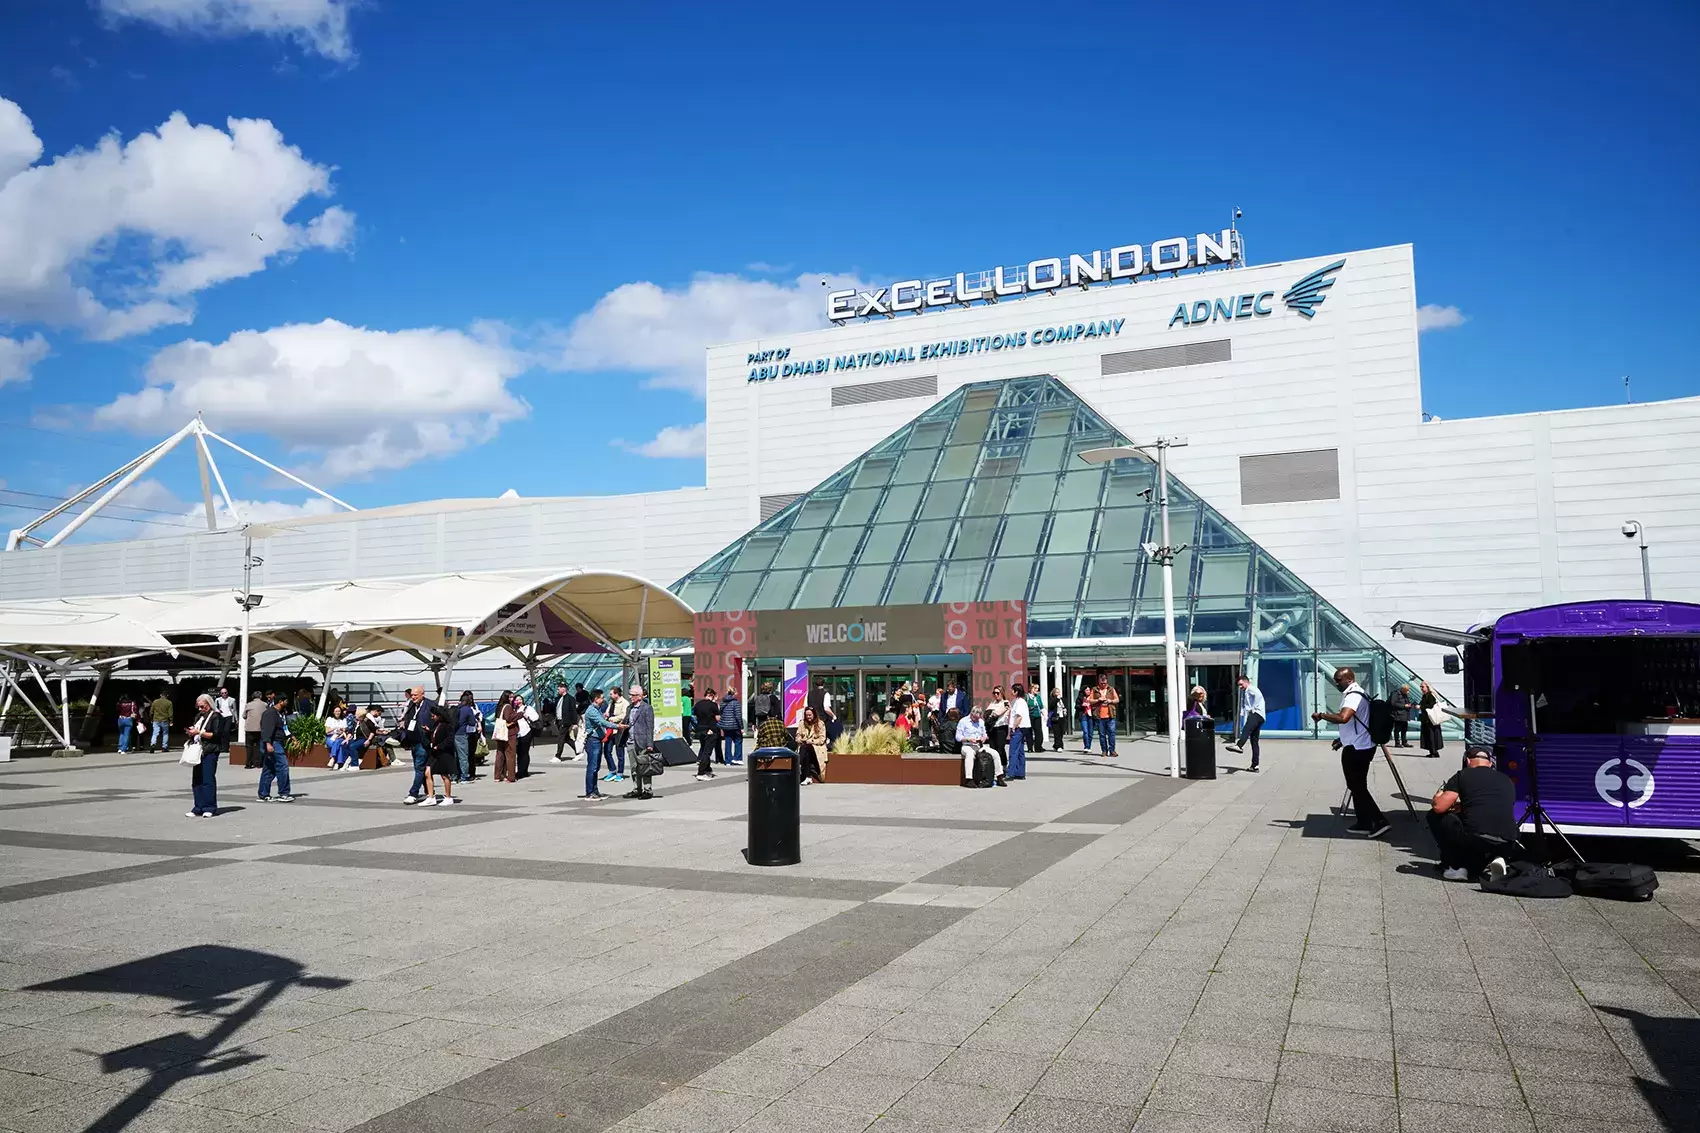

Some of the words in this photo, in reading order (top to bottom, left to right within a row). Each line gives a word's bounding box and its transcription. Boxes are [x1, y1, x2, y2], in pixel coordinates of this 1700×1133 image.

[994, 227, 1232, 295] LONDON
[1168, 290, 1275, 328] ADNEC
[746, 365, 779, 382] ABU
[781, 358, 831, 377] DHABI
[834, 348, 915, 371] NATIONAL
[920, 331, 1027, 360] EXHIBITIONS
[1030, 318, 1126, 345] COMPANY
[747, 349, 775, 365] PART
[776, 347, 791, 361] OF
[700, 628, 717, 646] TO
[722, 627, 746, 646] TO
[806, 622, 887, 644] WELCOME
[975, 619, 997, 639] TO
[696, 651, 713, 669] TO
[971, 645, 992, 665] TO
[653, 671, 661, 681] S2
[973, 671, 993, 691] TO
[653, 688, 661, 699] S3
